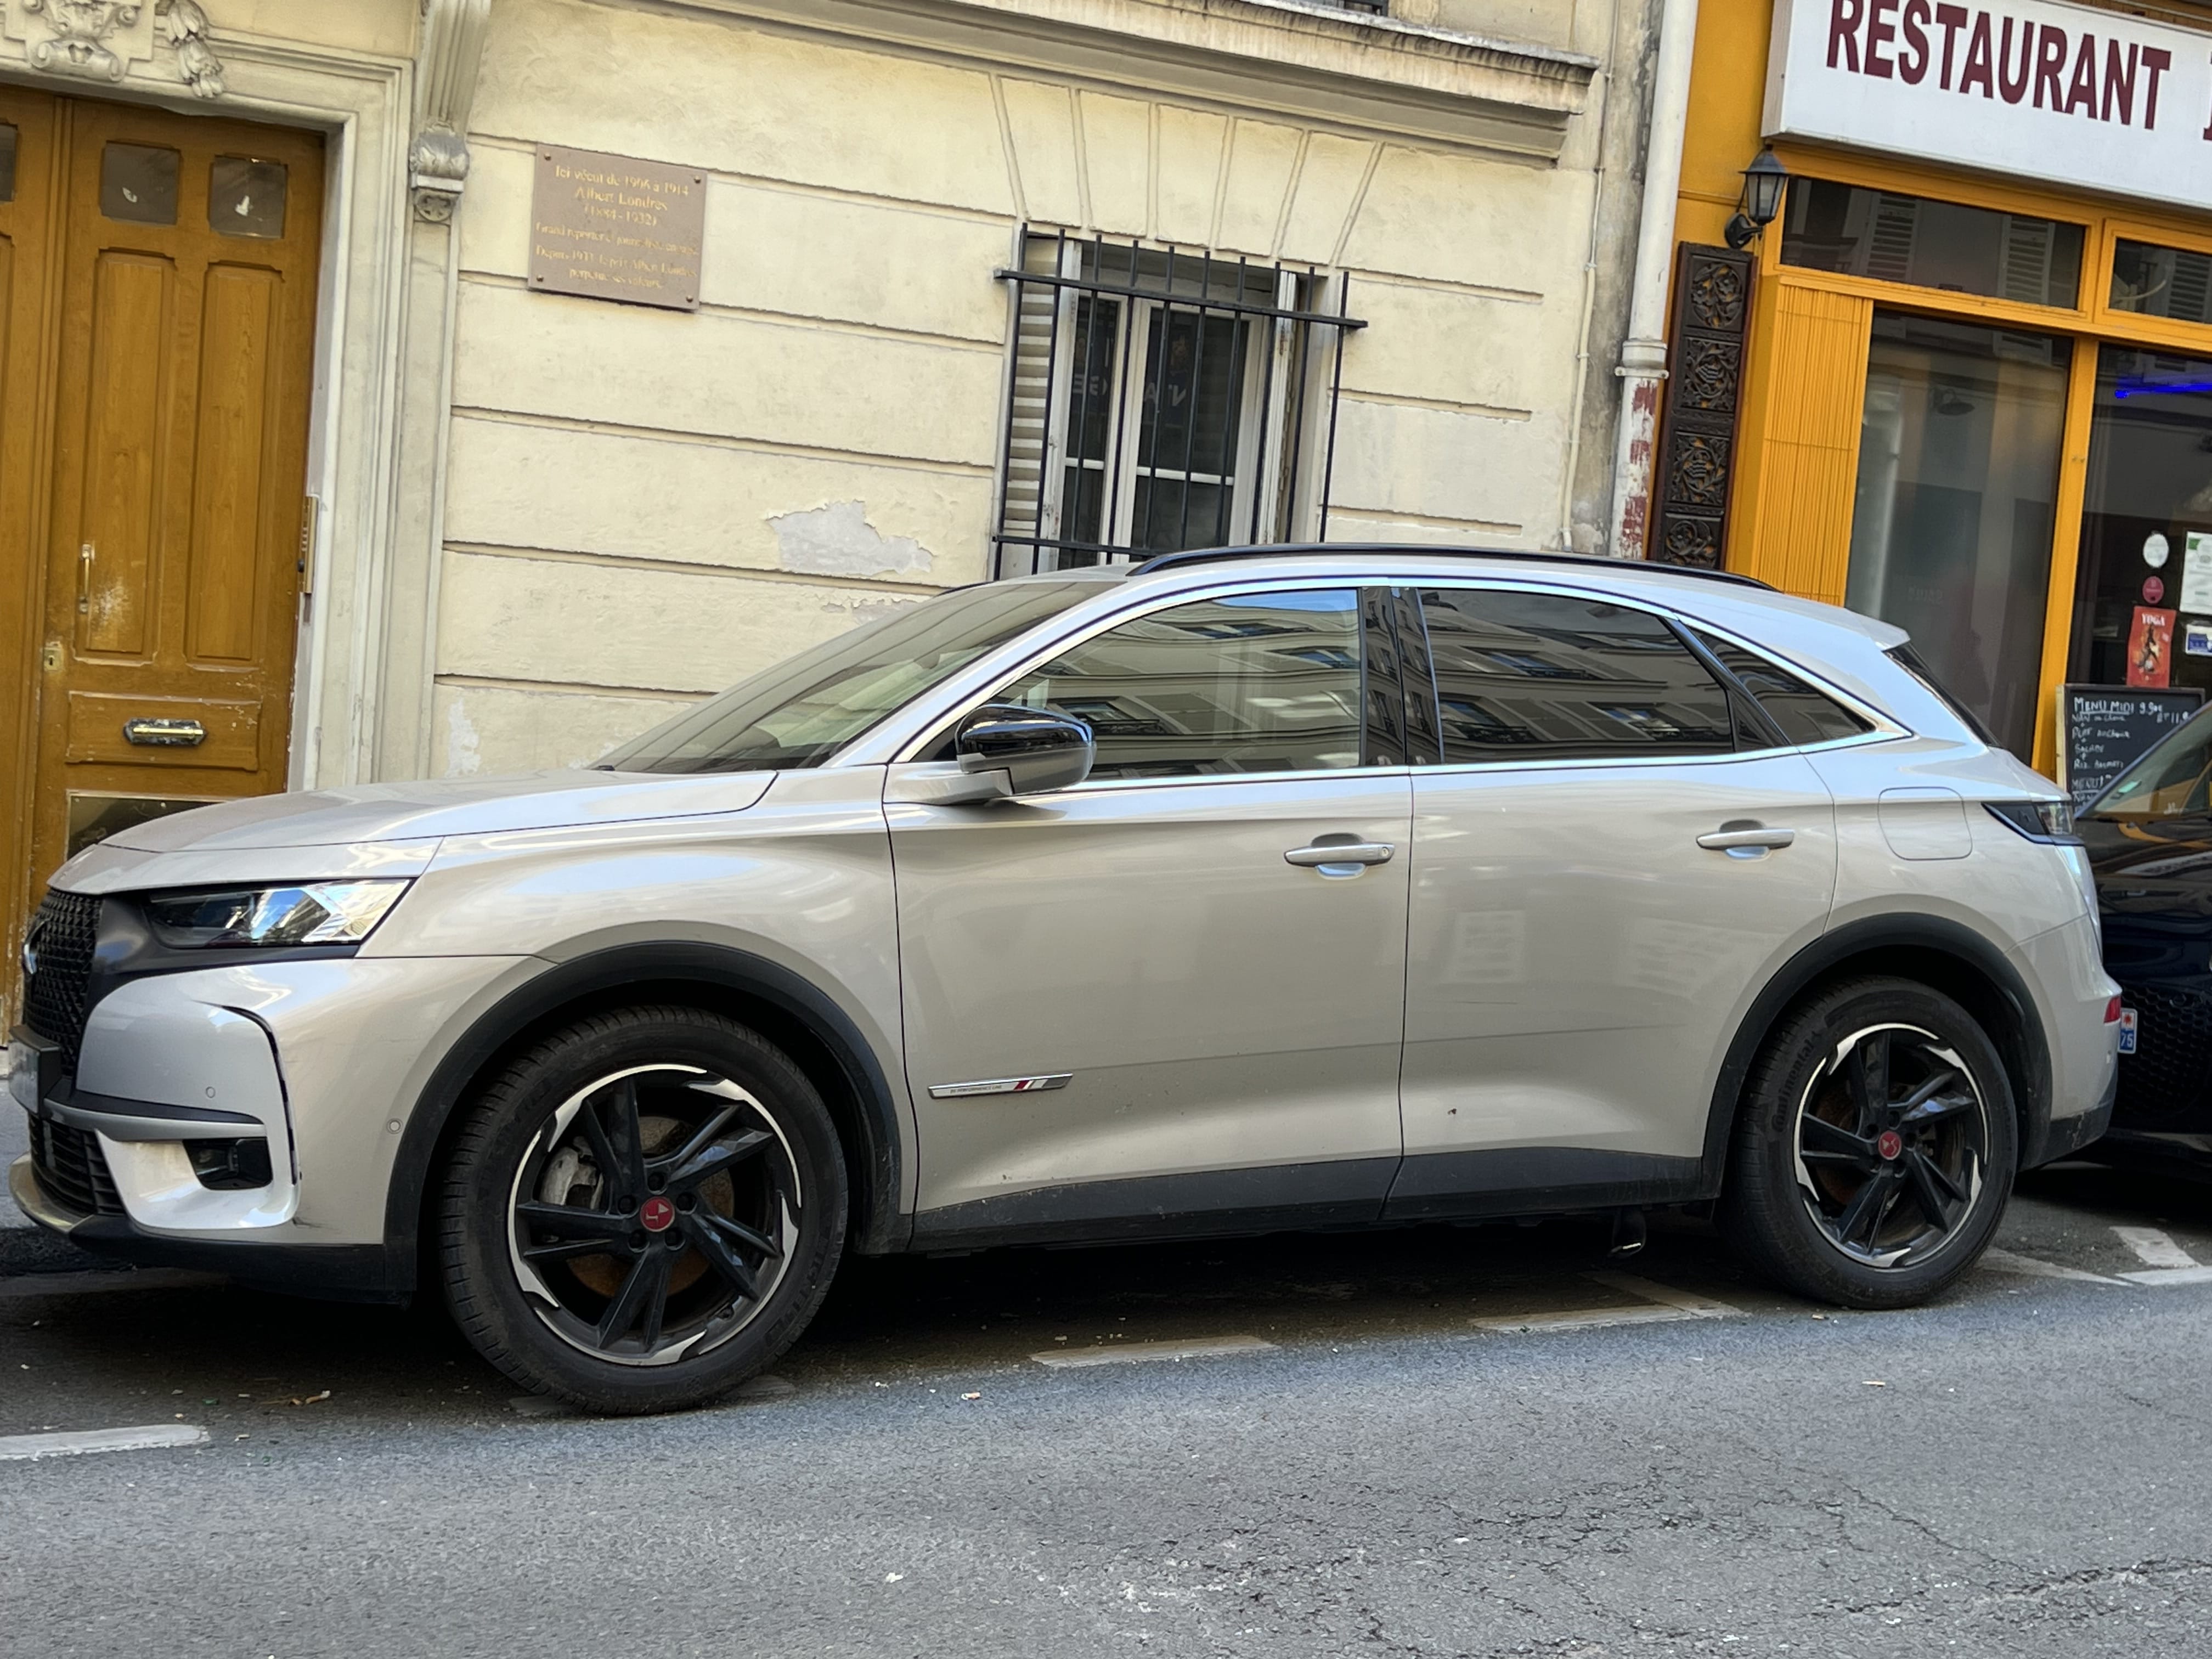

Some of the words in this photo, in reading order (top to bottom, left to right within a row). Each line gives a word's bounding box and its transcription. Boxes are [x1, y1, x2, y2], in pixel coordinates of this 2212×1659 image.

[1826, 0, 2171, 131] RESTAURANT
[556, 165, 571, 178] Ici
[574, 169, 603, 184] vécut
[606, 173, 619, 187] de
[664, 182, 689, 196] 1914
[574, 186, 614, 203] Albert
[618, 192, 668, 211] Londres
[536, 222, 565, 236] Grand
[567, 228, 604, 241] reporter
[2142, 613, 2165, 627] YOGA
[2074, 697, 2107, 713] MENU
[2111, 701, 2134, 713] MIDI
[2121, 1032, 2134, 1048] 75
[1772, 1040, 1814, 1132] Continental
